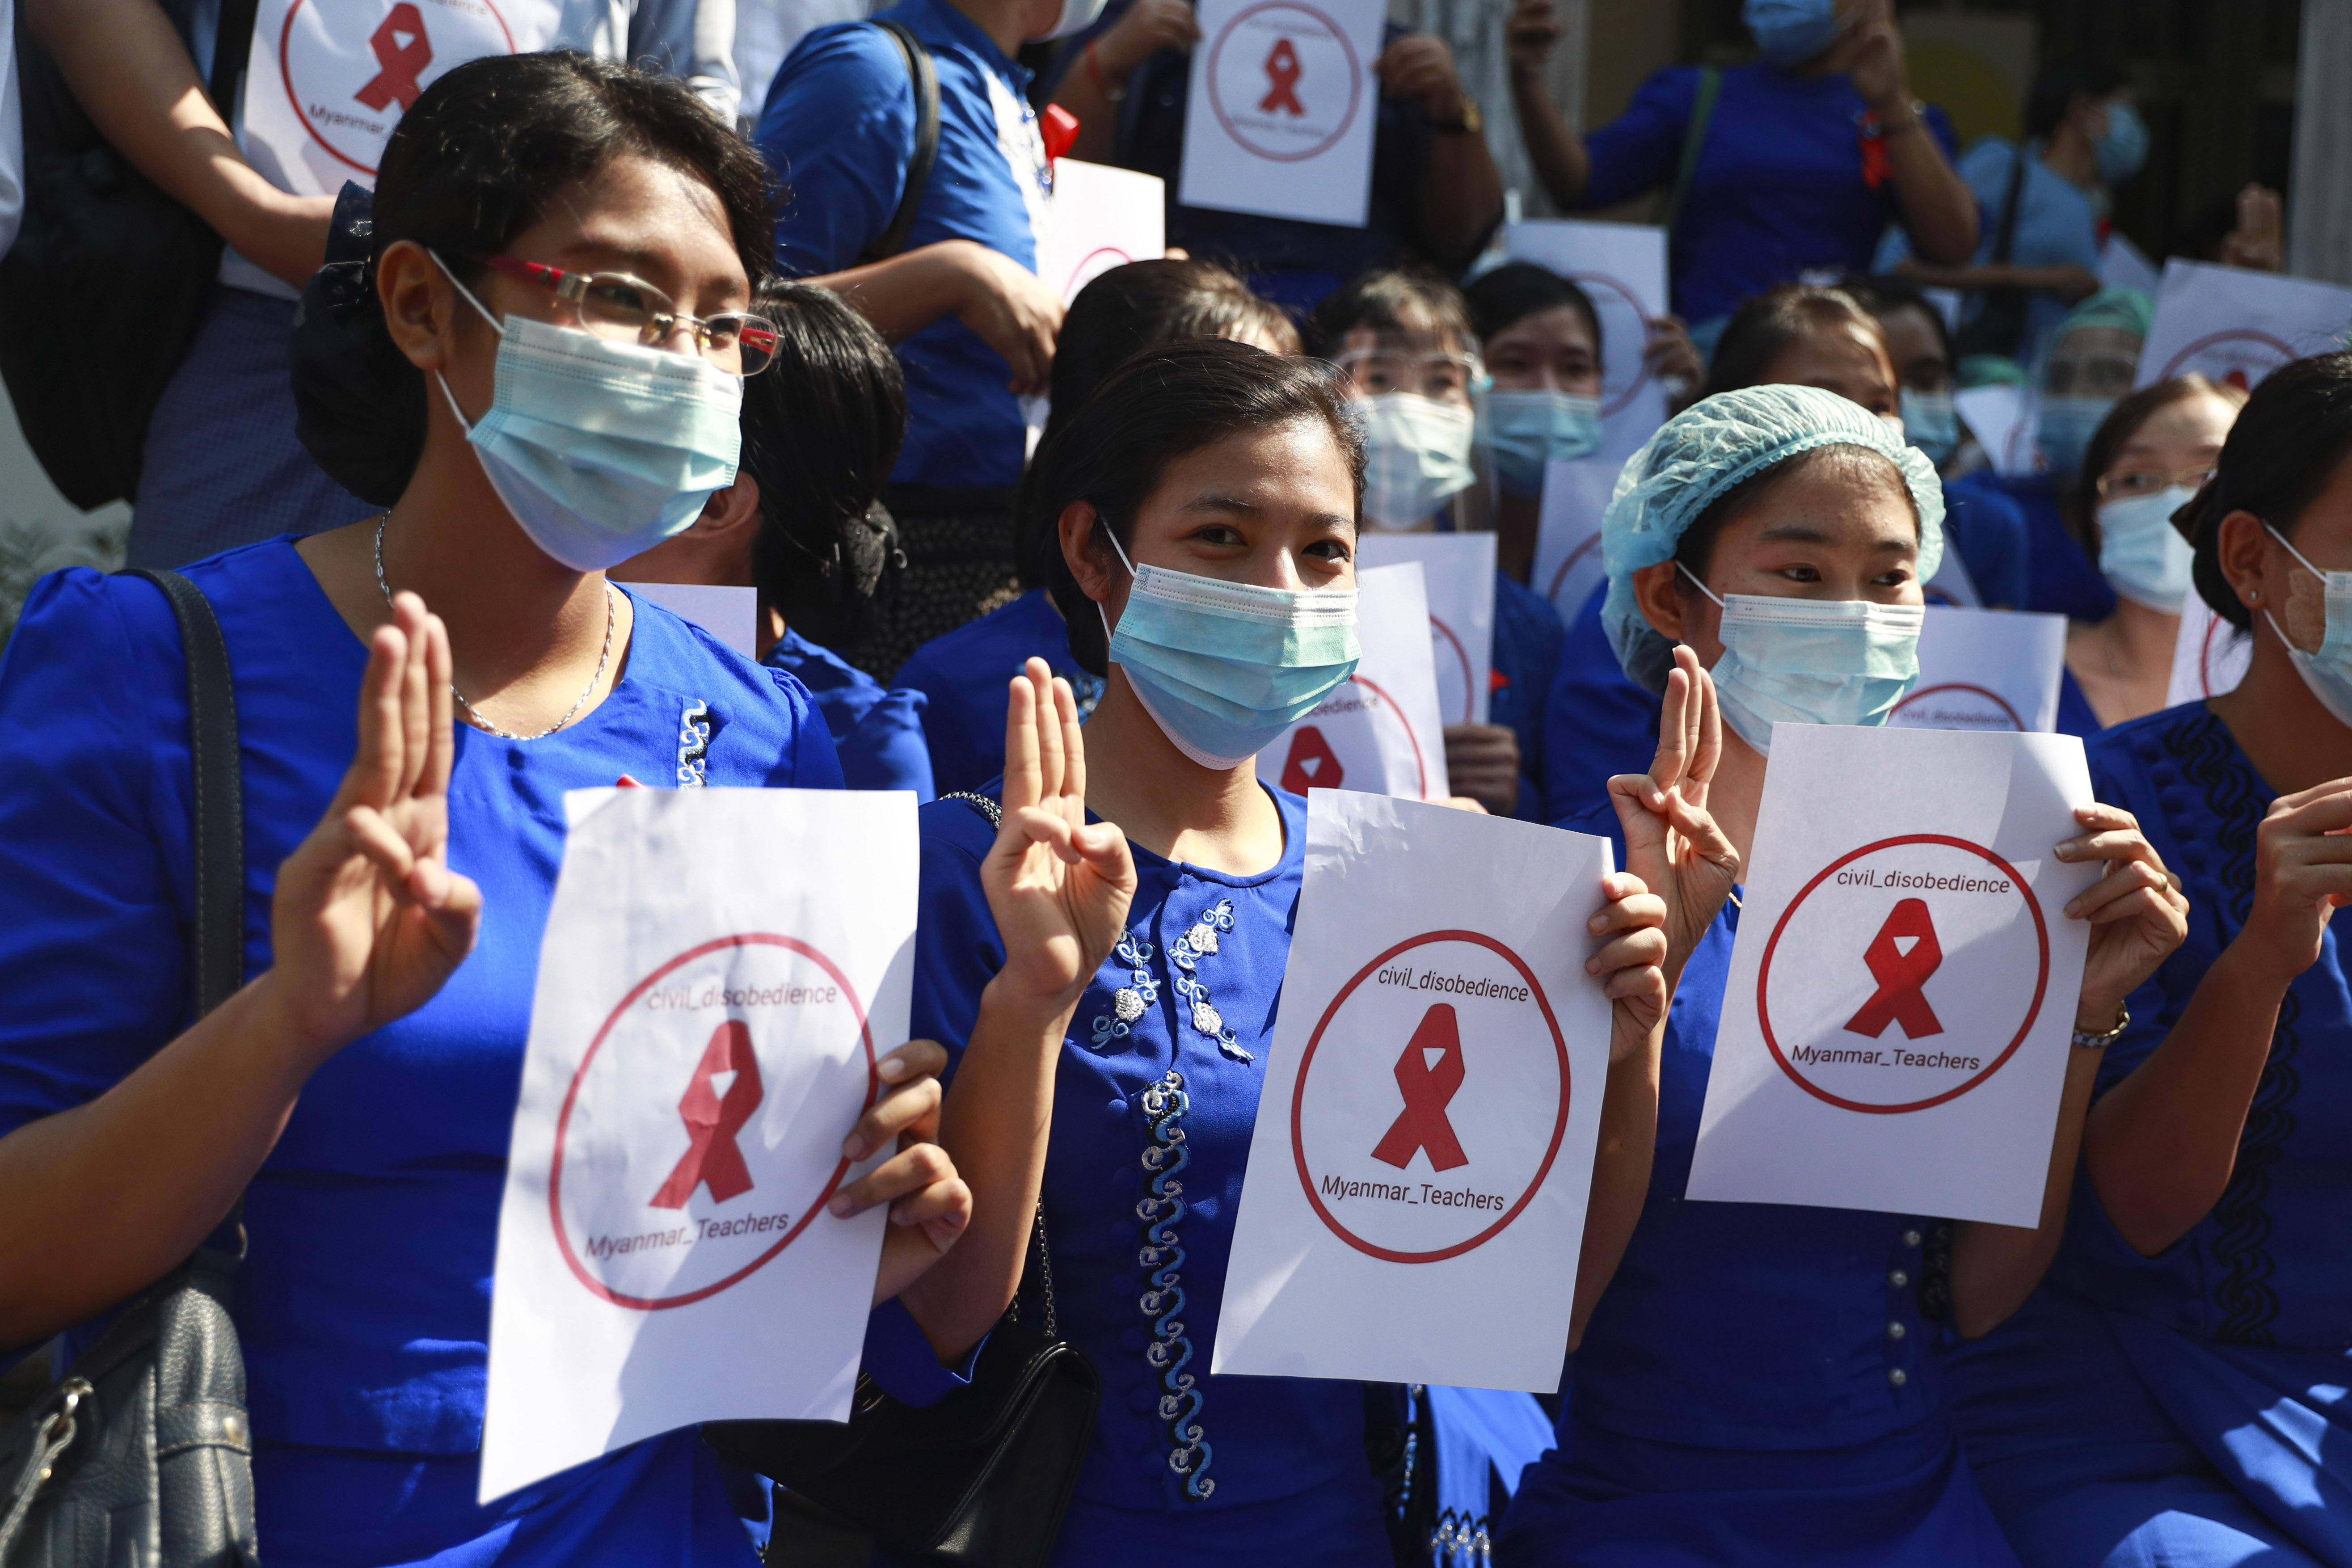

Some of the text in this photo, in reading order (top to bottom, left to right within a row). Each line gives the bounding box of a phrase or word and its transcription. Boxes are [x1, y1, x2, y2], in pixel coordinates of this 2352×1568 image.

[1837, 869, 2010, 893] civil_disobedience
[648, 984, 836, 1011] civil_disobedience
[1378, 967, 1527, 1001] civil_disobedience
[1792, 1045, 1979, 1070] Myanmar_Teachers
[1321, 1175, 1504, 1210] Myanmar_Teachers
[585, 1211, 789, 1260] Myanmar_Teachers
